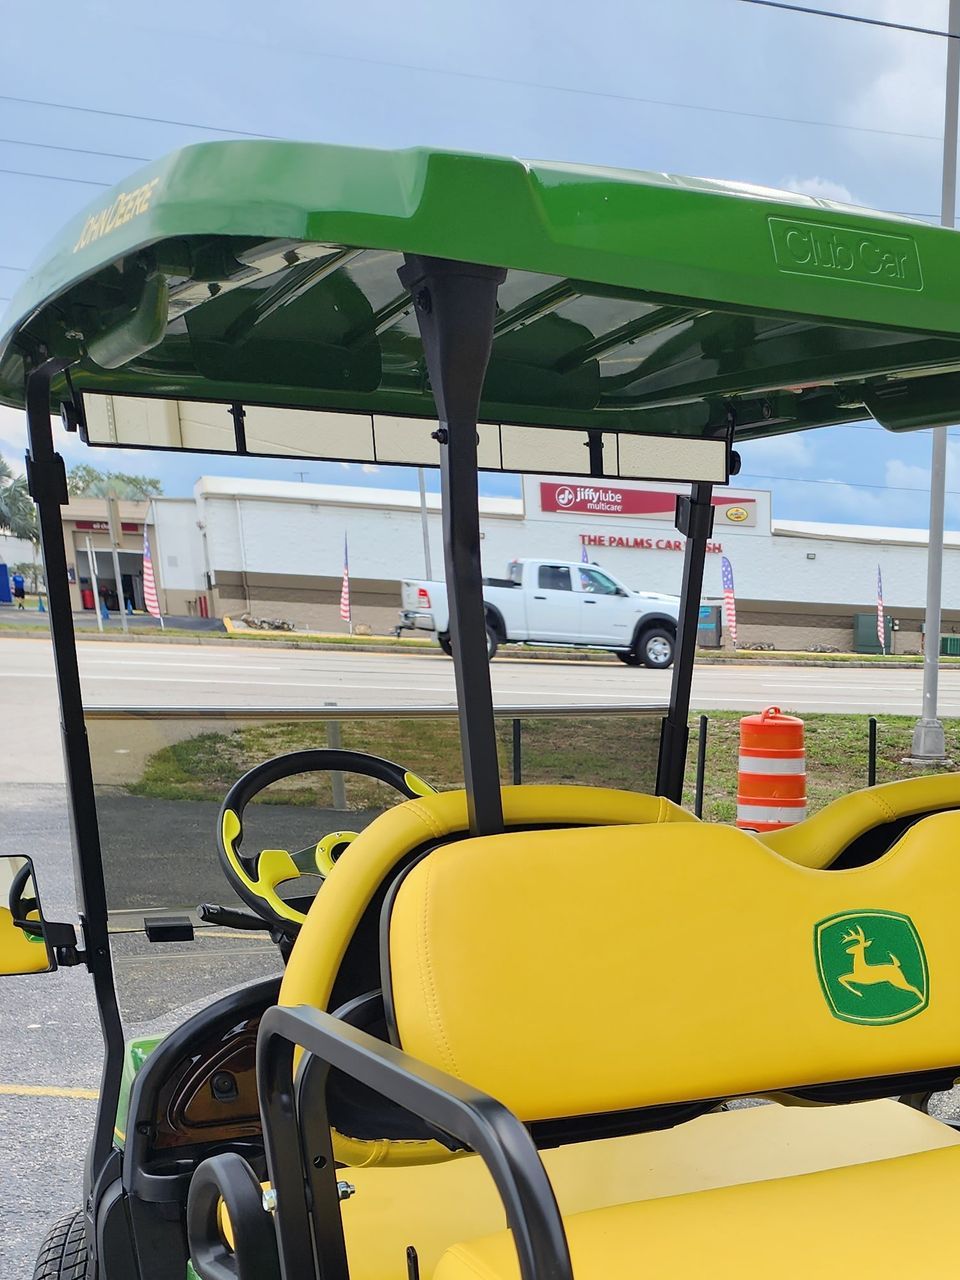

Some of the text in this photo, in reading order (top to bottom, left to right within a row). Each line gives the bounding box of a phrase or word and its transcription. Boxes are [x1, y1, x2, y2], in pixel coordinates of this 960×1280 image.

[113, 177, 160, 228] DEERE
[785, 228, 907, 279] Club Car
[587, 501, 622, 512] multicare
[579, 534, 606, 546] THE
[608, 536, 653, 549] PALMS
[655, 539, 682, 551] CAR
